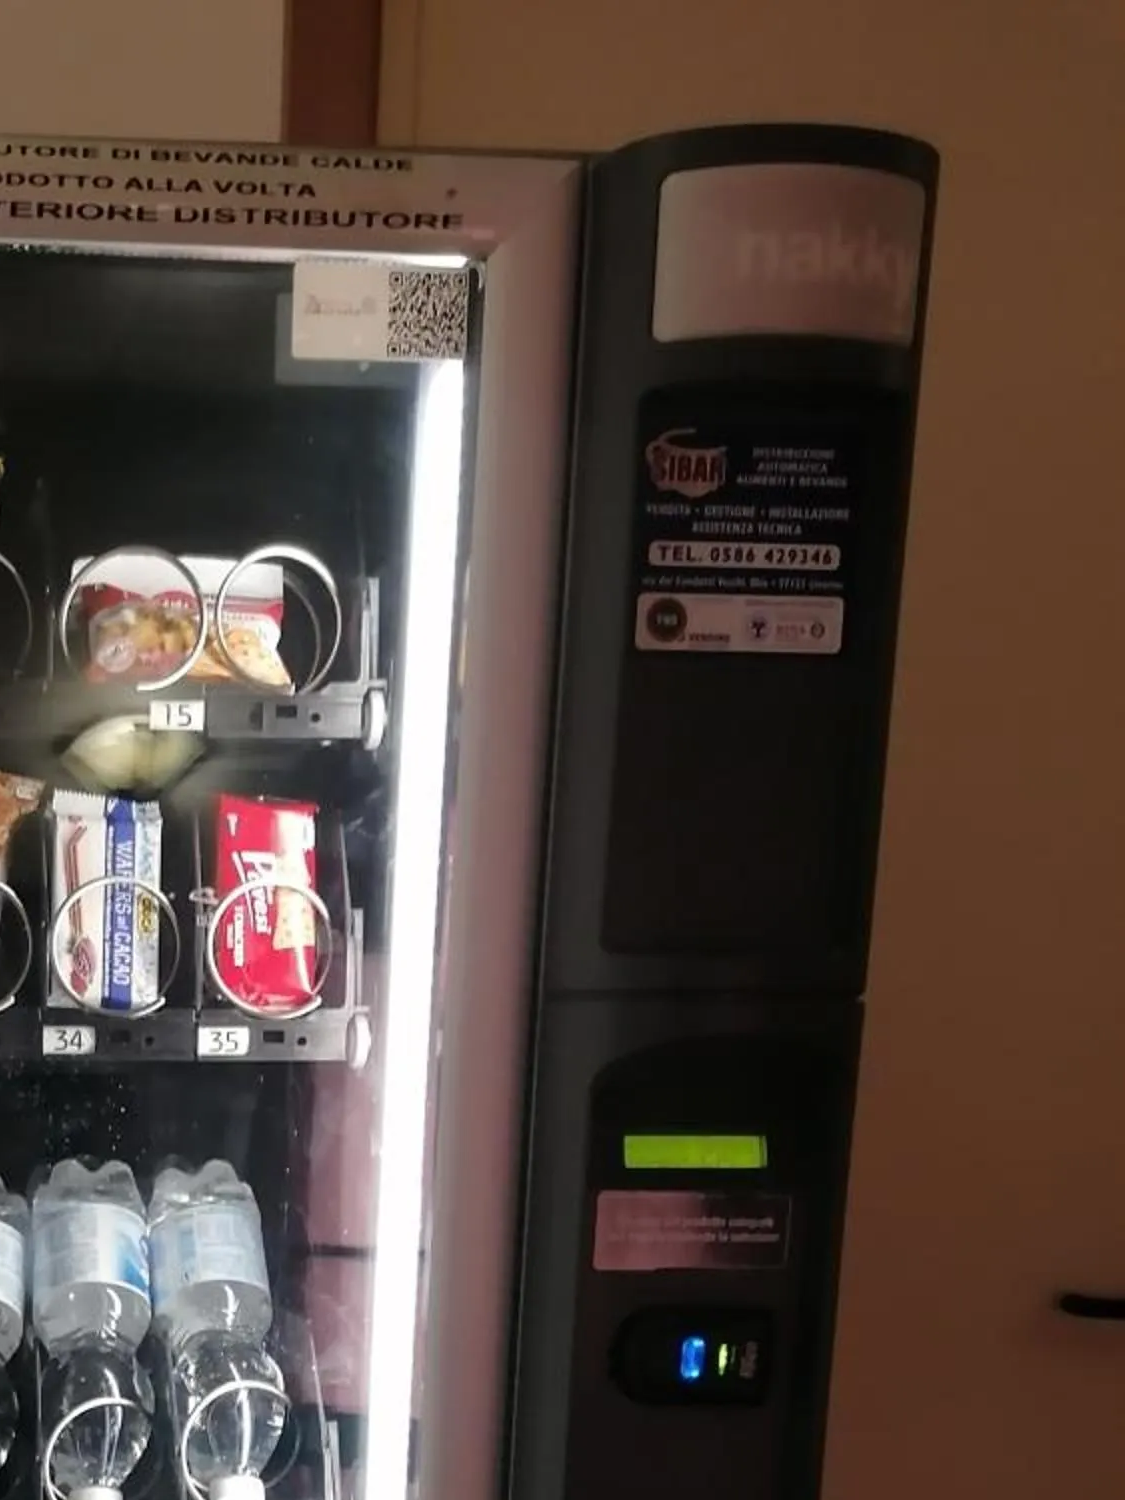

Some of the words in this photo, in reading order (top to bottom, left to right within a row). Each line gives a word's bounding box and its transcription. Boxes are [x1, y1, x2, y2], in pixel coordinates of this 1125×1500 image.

[111, 147, 140, 160] DI
[150, 149, 300, 167] BEVANDE
[311, 155, 413, 172] CALDE
[125, 176, 203, 193] ALLA
[213, 179, 317, 198] VOLTA
[173, 206, 465, 230] DISTRIBUTORE
[657, 544, 703, 563] TEL.
[709, 546, 756, 563] 0586
[165, 702, 192, 726] 15
[114, 840, 134, 916] WAFERS
[112, 931, 132, 987] CACAO
[53, 1029, 82, 1051] 34
[209, 1031, 238, 1052] 35
